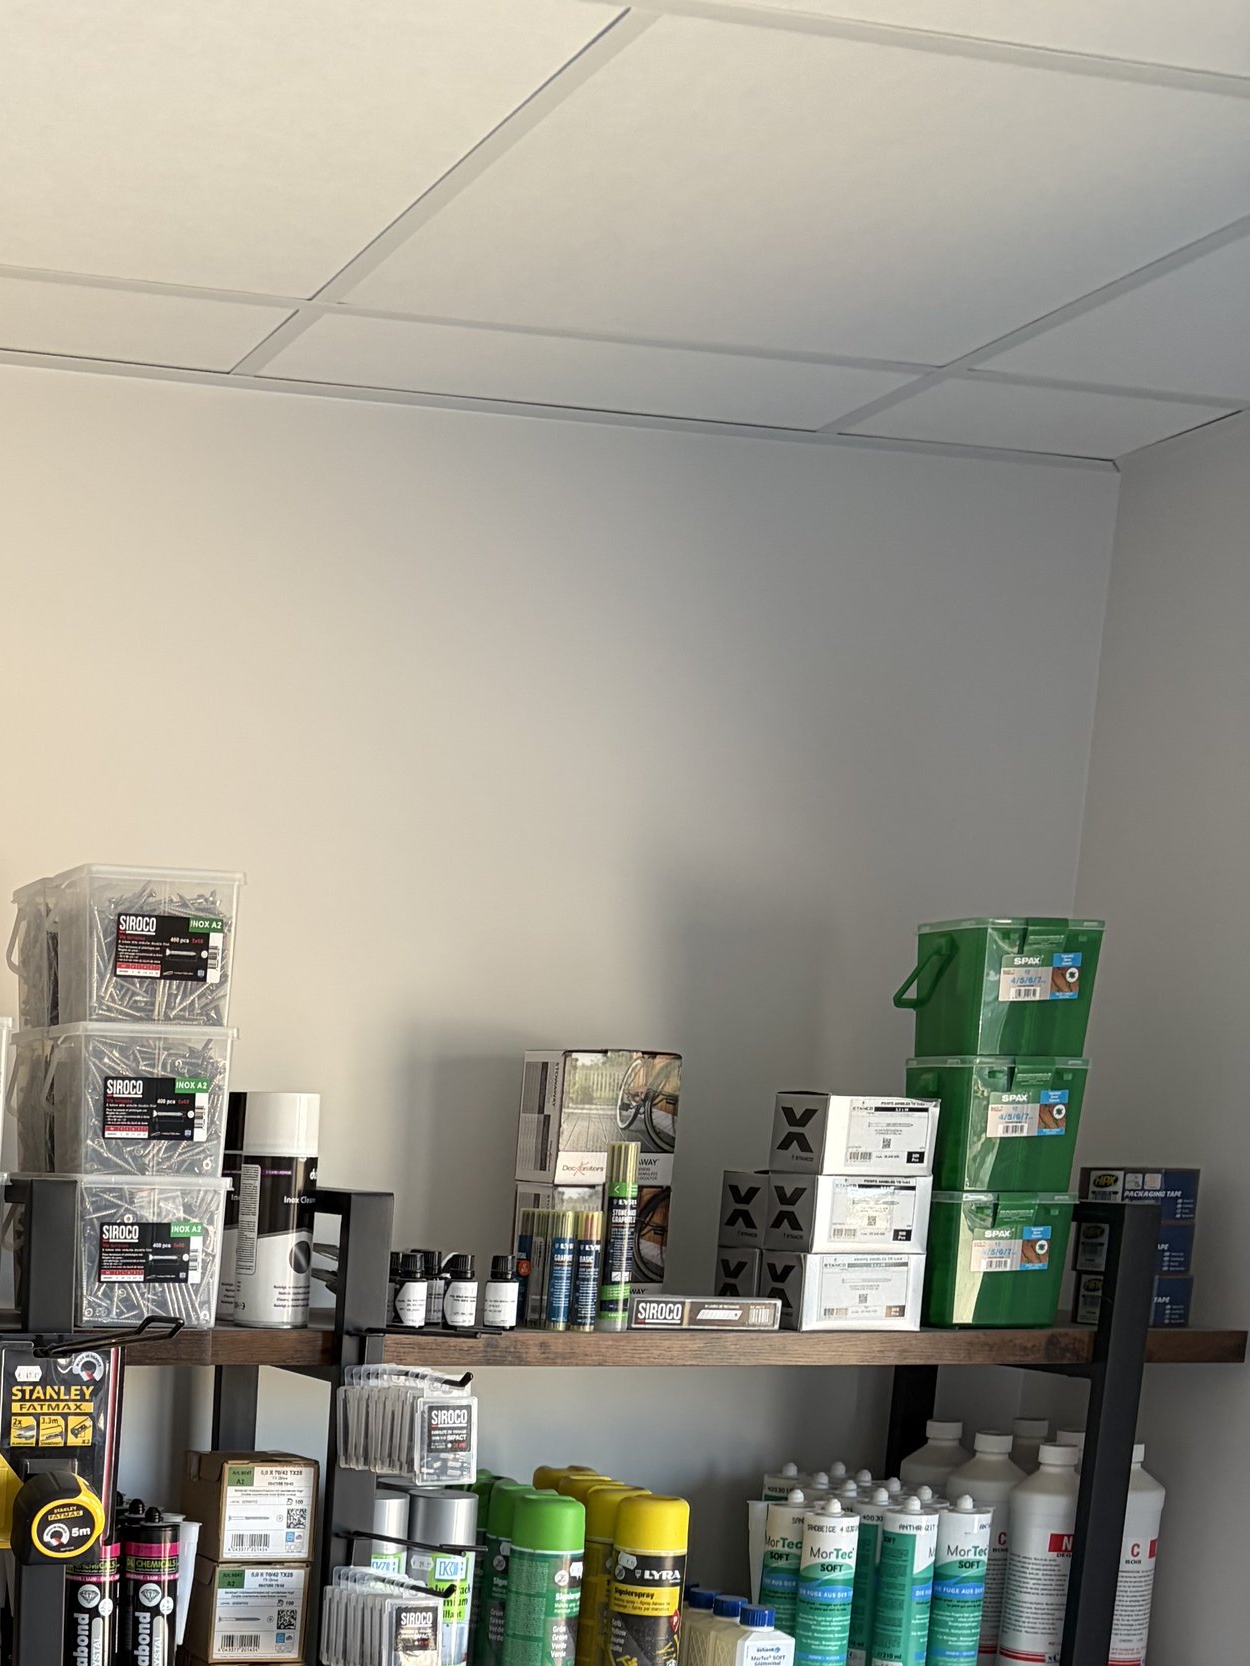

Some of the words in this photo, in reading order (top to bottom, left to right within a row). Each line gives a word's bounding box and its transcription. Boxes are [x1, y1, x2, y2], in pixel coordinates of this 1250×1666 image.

[119, 916, 157, 932] SIROCO
[1014, 957, 1040, 965] SPAX
[107, 1080, 143, 1095] SIROCO
[1002, 1094, 1027, 1102] SPAX
[284, 1195, 299, 1204] Inox
[102, 1225, 138, 1240] SIROCO
[638, 1303, 682, 1319] SIROCO
[11, 1386, 94, 1400] STANLEY
[431, 1410, 467, 1425] SIROCO
[71, 1528, 91, 1537] 5m
[810, 1546, 853, 1560] MorTec
[947, 1545, 987, 1557] MorTec
[1131, 1543, 1140, 1557] C
[136, 1559, 177, 1568] CHEMICALS
[820, 1563, 843, 1572] SOFT
[644, 1570, 680, 1580] LYRA
[401, 1612, 432, 1626] SIROCO
